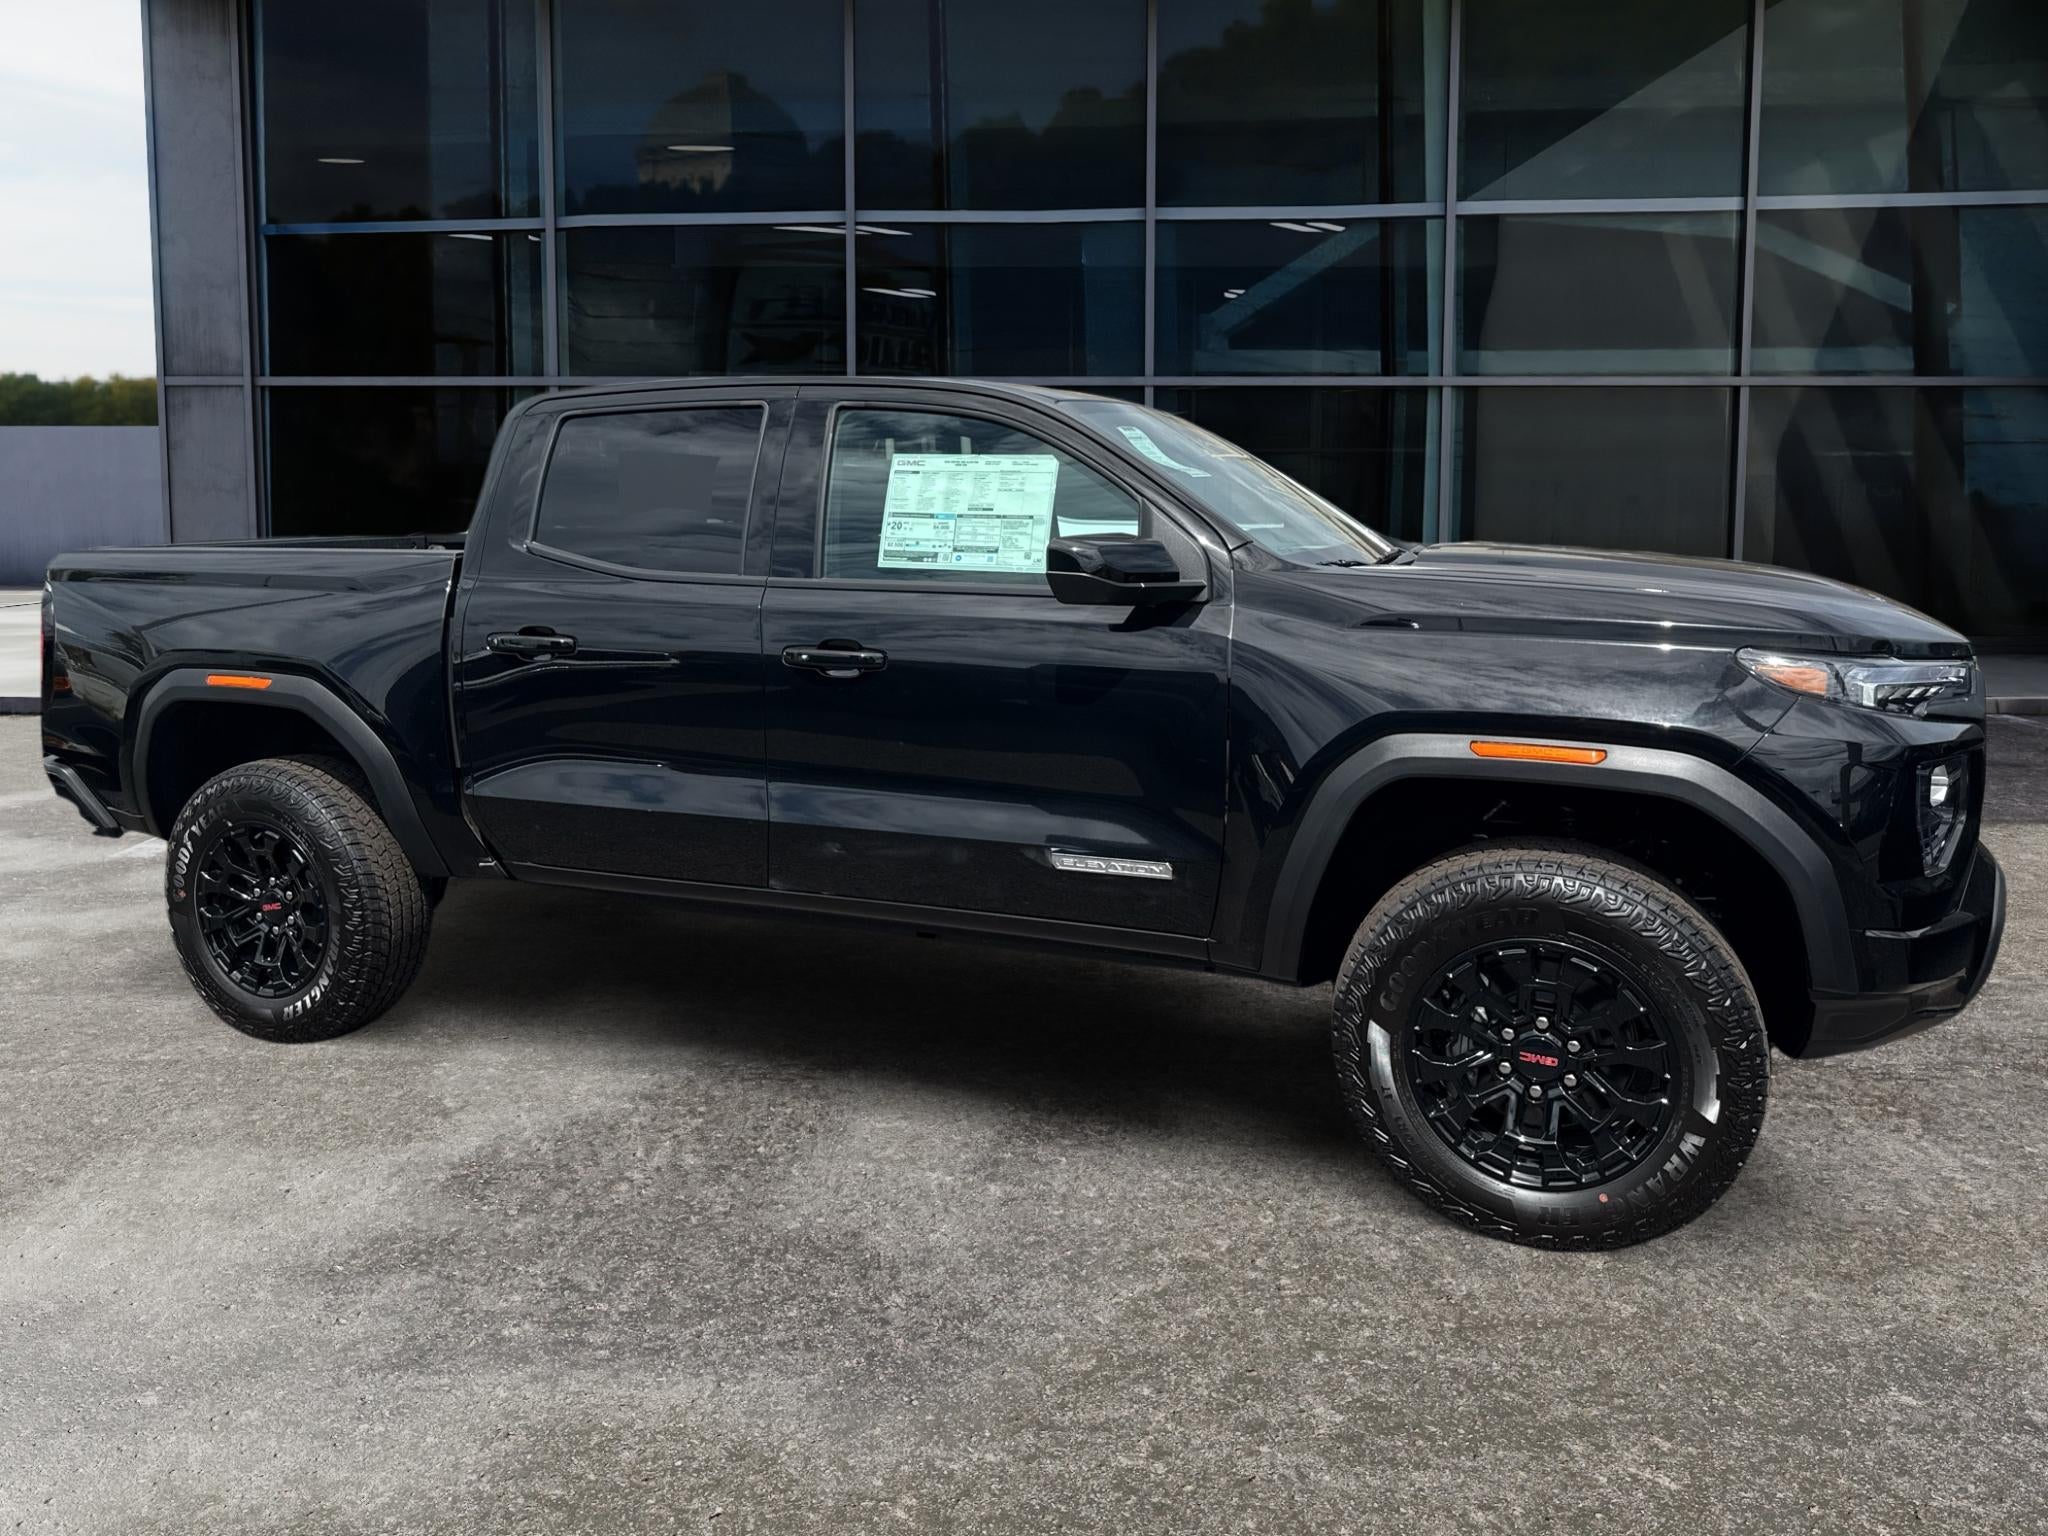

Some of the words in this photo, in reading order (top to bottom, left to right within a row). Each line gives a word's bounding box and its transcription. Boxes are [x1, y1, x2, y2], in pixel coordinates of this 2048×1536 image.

[1061, 857, 1165, 874] ELEVATION
[262, 902, 282, 912] GMC
[1519, 1051, 1559, 1067] GMC
